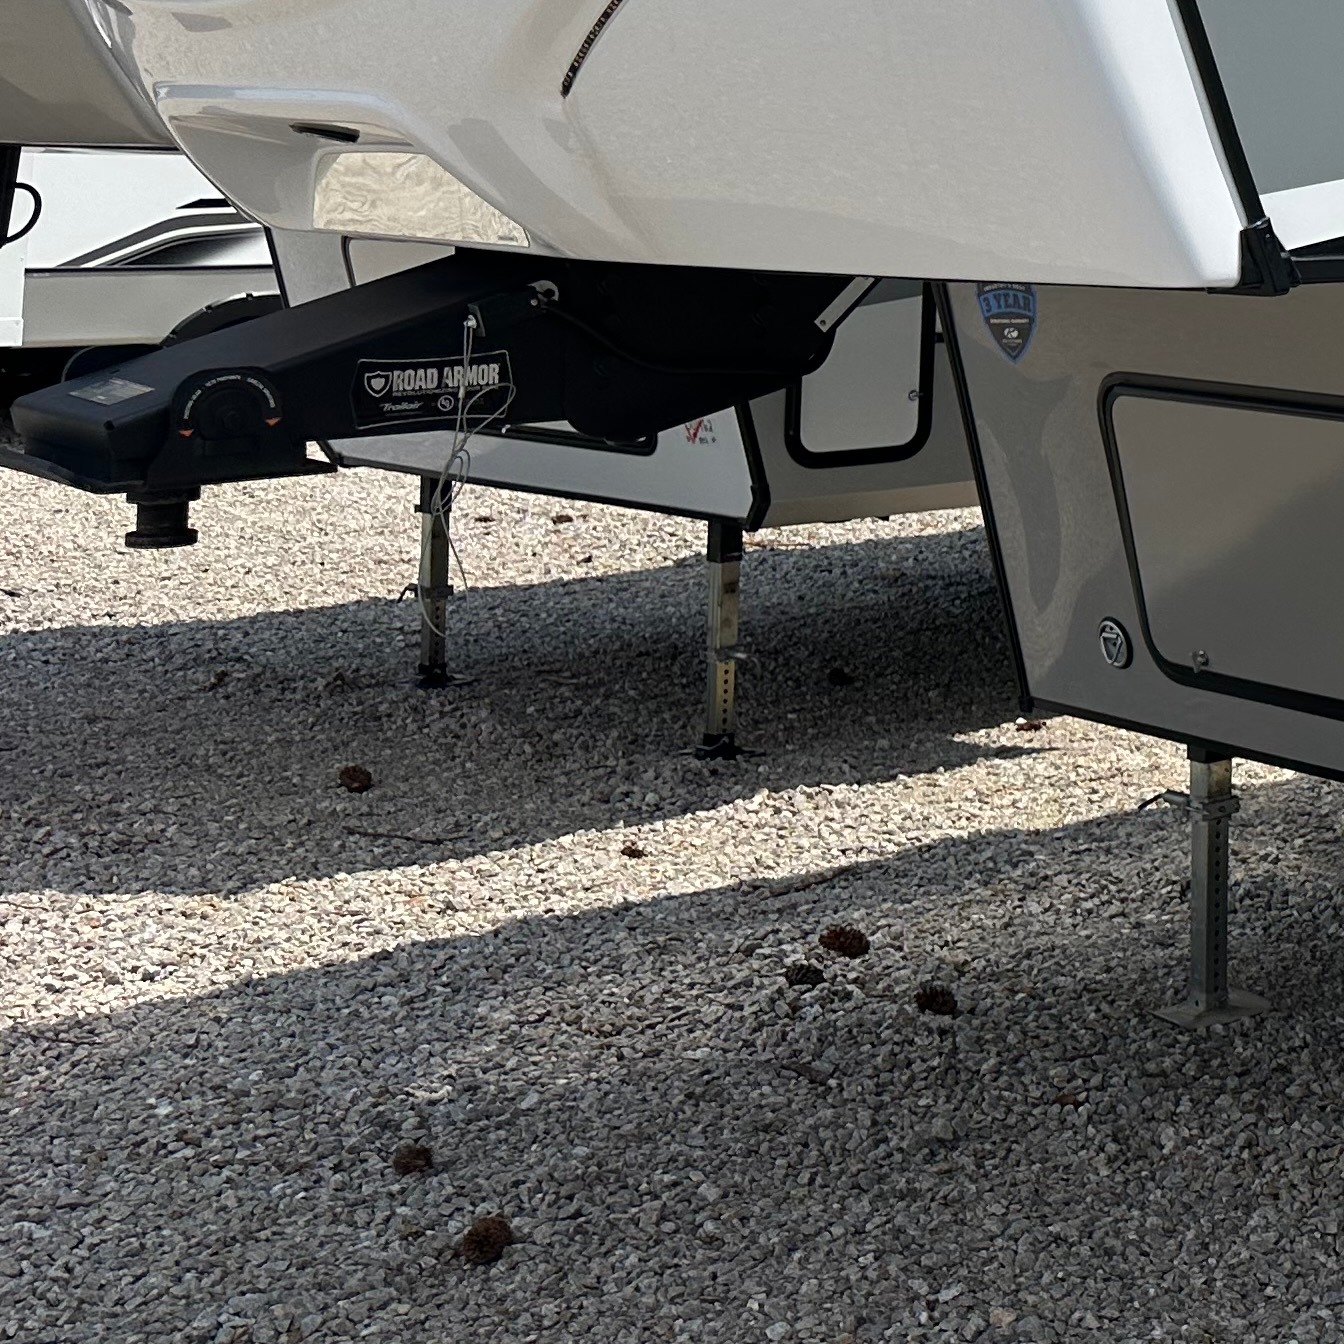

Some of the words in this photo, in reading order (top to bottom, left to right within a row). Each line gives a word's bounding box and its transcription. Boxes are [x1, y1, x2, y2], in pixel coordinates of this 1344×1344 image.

[982, 296, 993, 313] 3
[993, 292, 1033, 314] YEAR
[392, 367, 439, 392] ROAD
[441, 363, 500, 387] ARMOR
